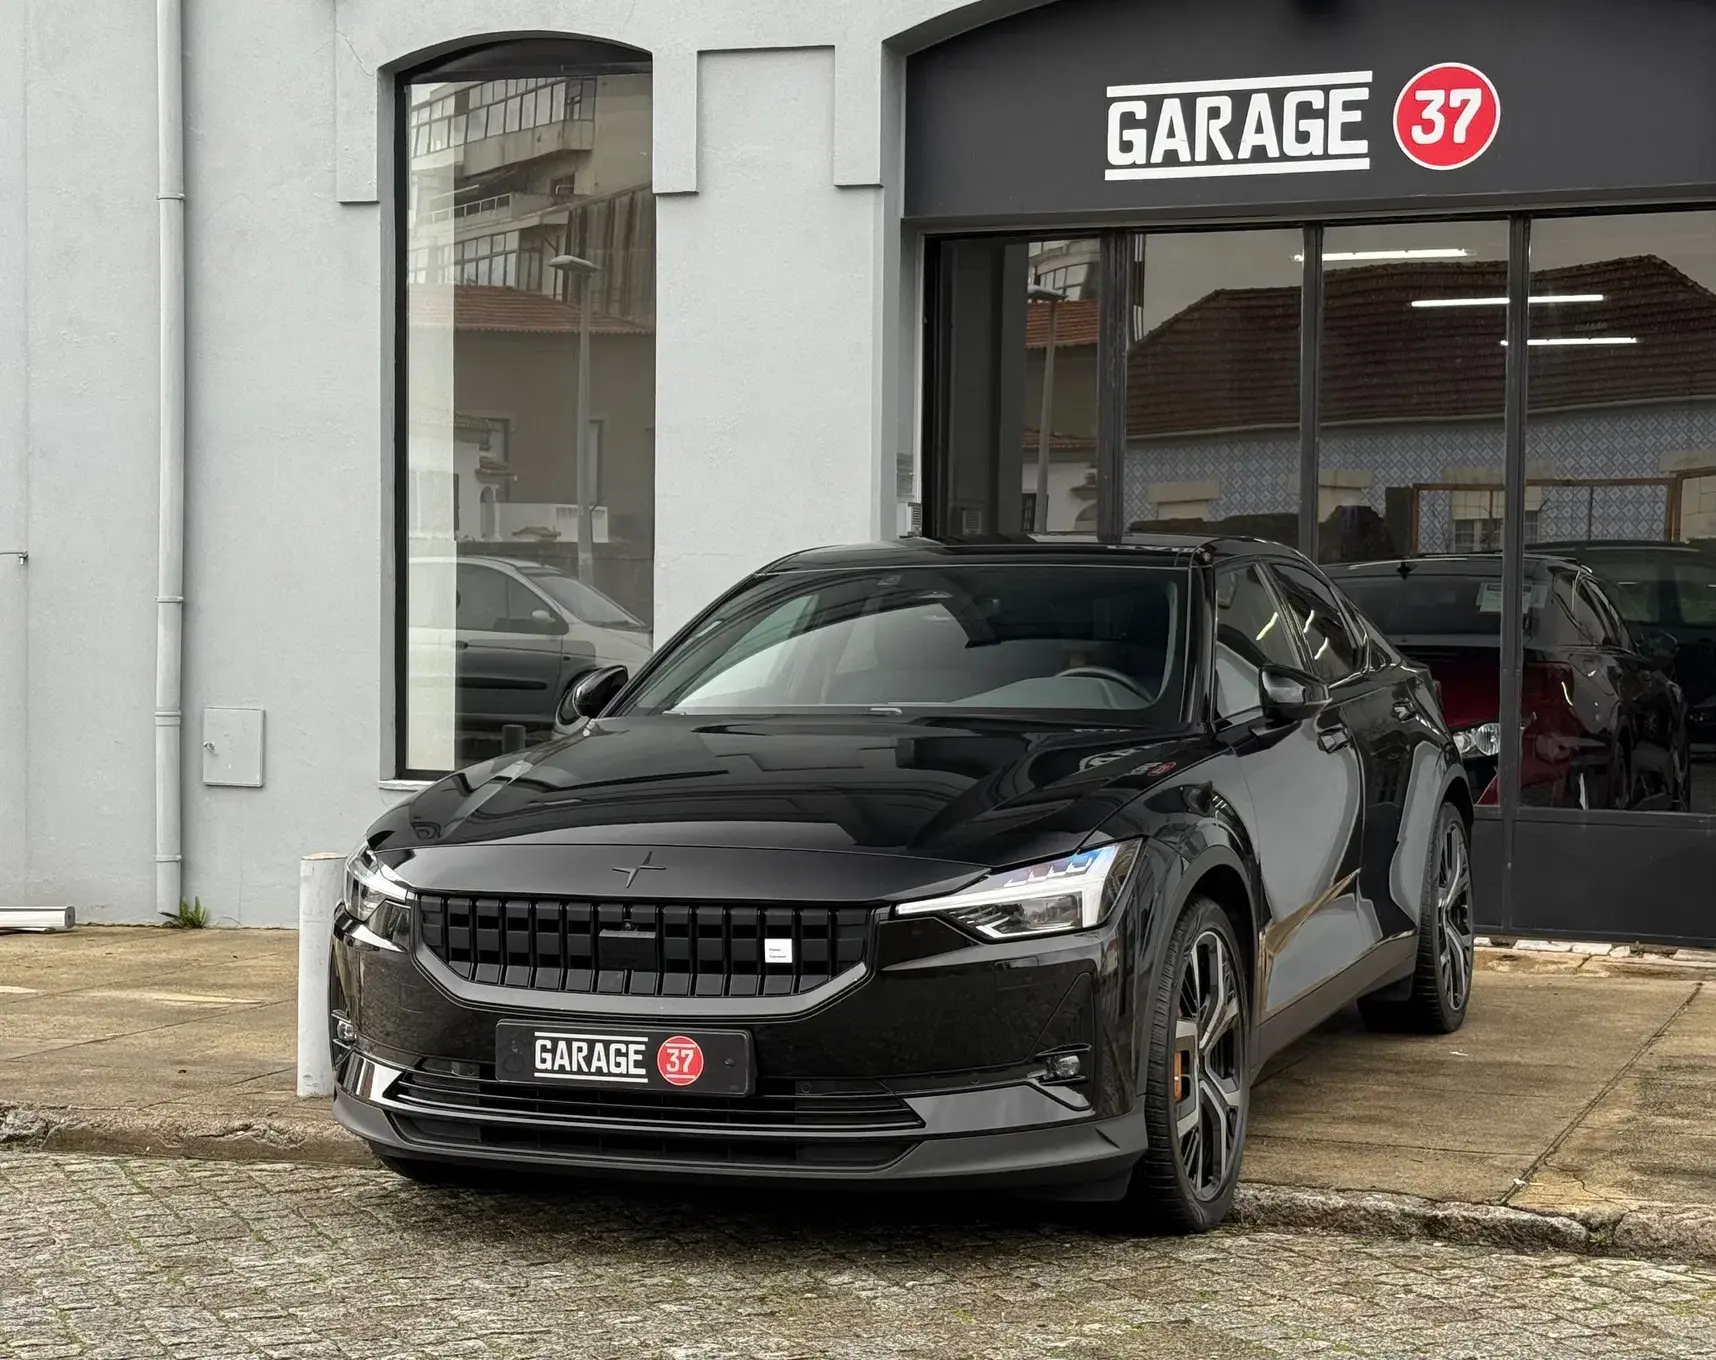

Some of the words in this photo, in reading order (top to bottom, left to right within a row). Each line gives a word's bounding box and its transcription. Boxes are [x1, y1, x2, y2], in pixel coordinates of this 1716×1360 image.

[1107, 87, 1370, 166] GARAGE
[1411, 87, 1482, 145] 37
[534, 1039, 647, 1075] GARAGE
[666, 1048, 694, 1073] 37
